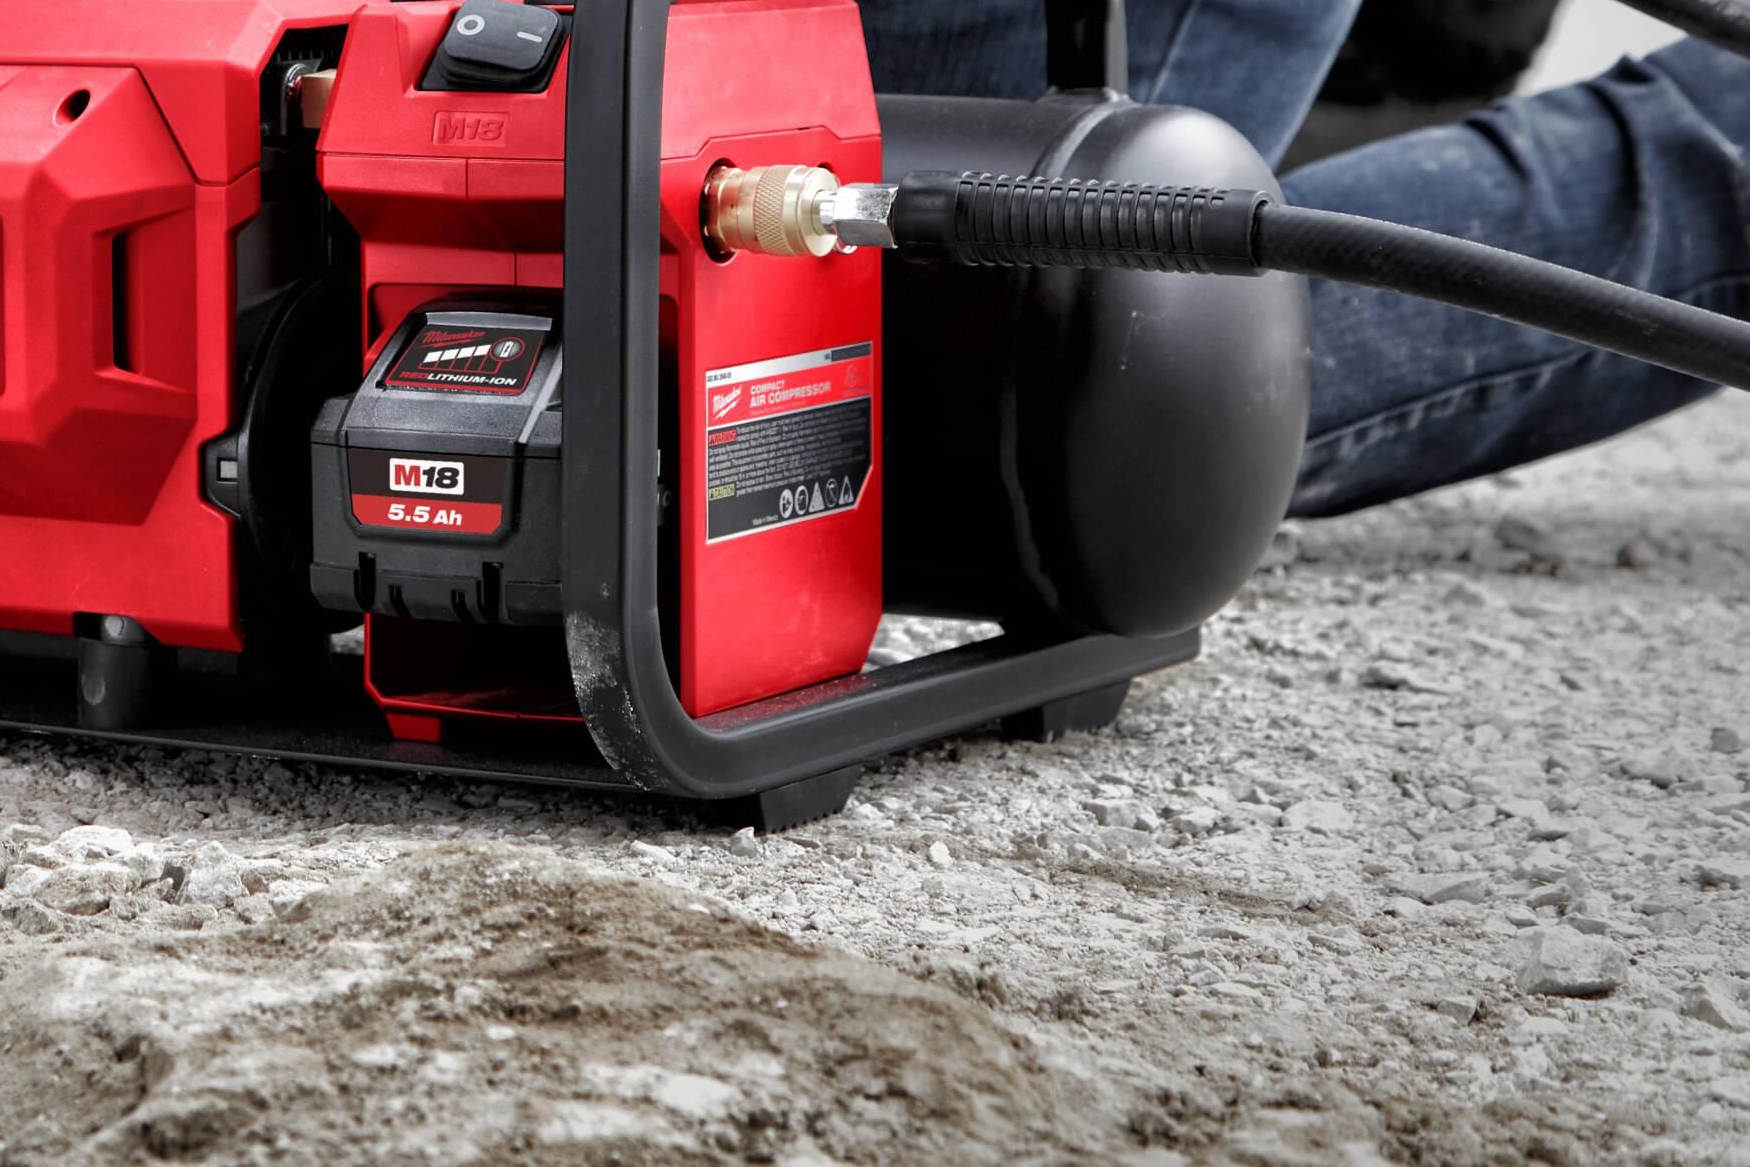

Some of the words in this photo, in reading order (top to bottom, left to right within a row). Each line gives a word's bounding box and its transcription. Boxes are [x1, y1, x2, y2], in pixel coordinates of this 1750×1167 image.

[436, 117, 505, 144] M18
[750, 380, 786, 395] COMPACT
[750, 394, 767, 408] AIR
[768, 381, 831, 404] COMPRESSOR
[394, 464, 460, 489] M18
[387, 503, 430, 523] 5.5
[433, 510, 462, 526] Ah
